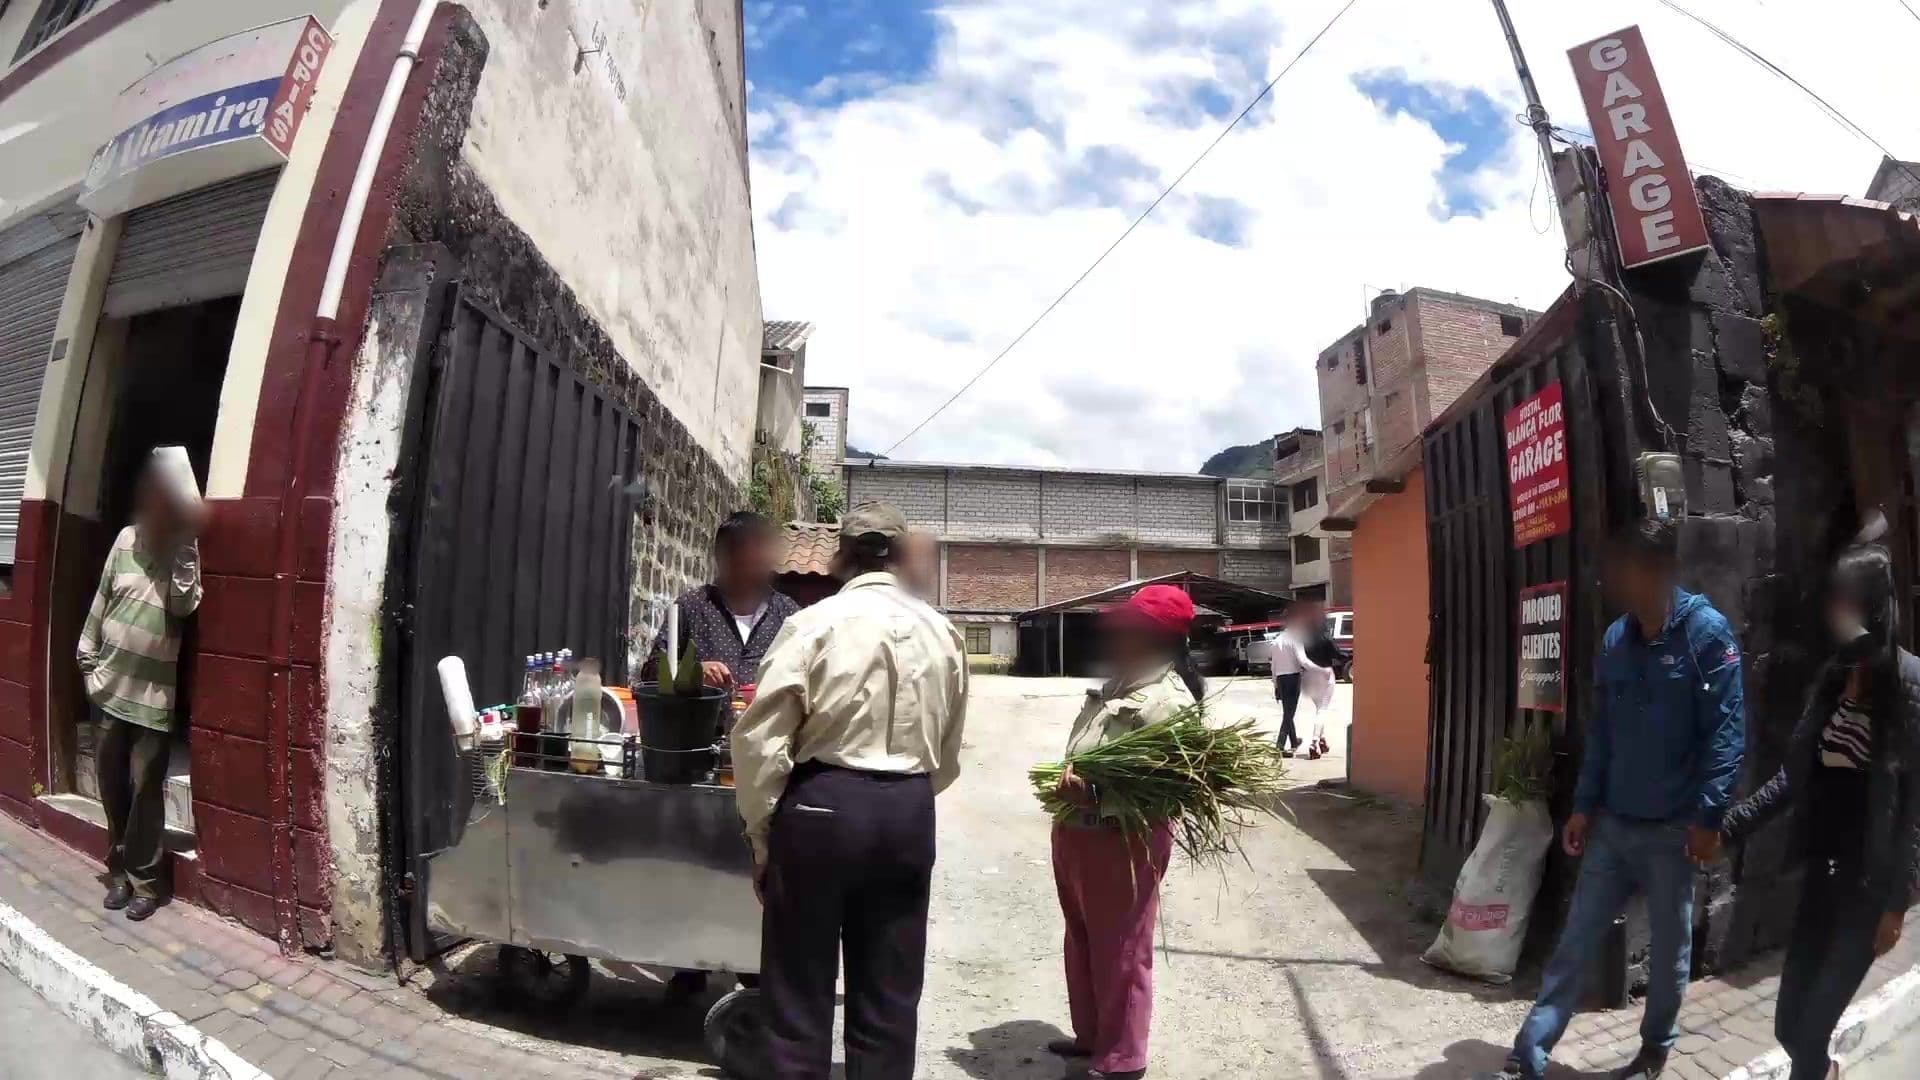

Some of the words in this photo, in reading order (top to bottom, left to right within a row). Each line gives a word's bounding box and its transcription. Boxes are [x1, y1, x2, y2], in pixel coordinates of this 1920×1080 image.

[271, 27, 325, 143] COPIAS
[1589, 38, 1681, 252] GARAGE
[1507, 417, 1537, 449] BLANCA
[1538, 402, 1562, 431] FLOR
[1519, 398, 1541, 422] HOSTAL
[1510, 430, 1563, 484] GARAGE
[1522, 593, 1562, 626] PARQUEO
[1521, 631, 1561, 660] CLIENTES
